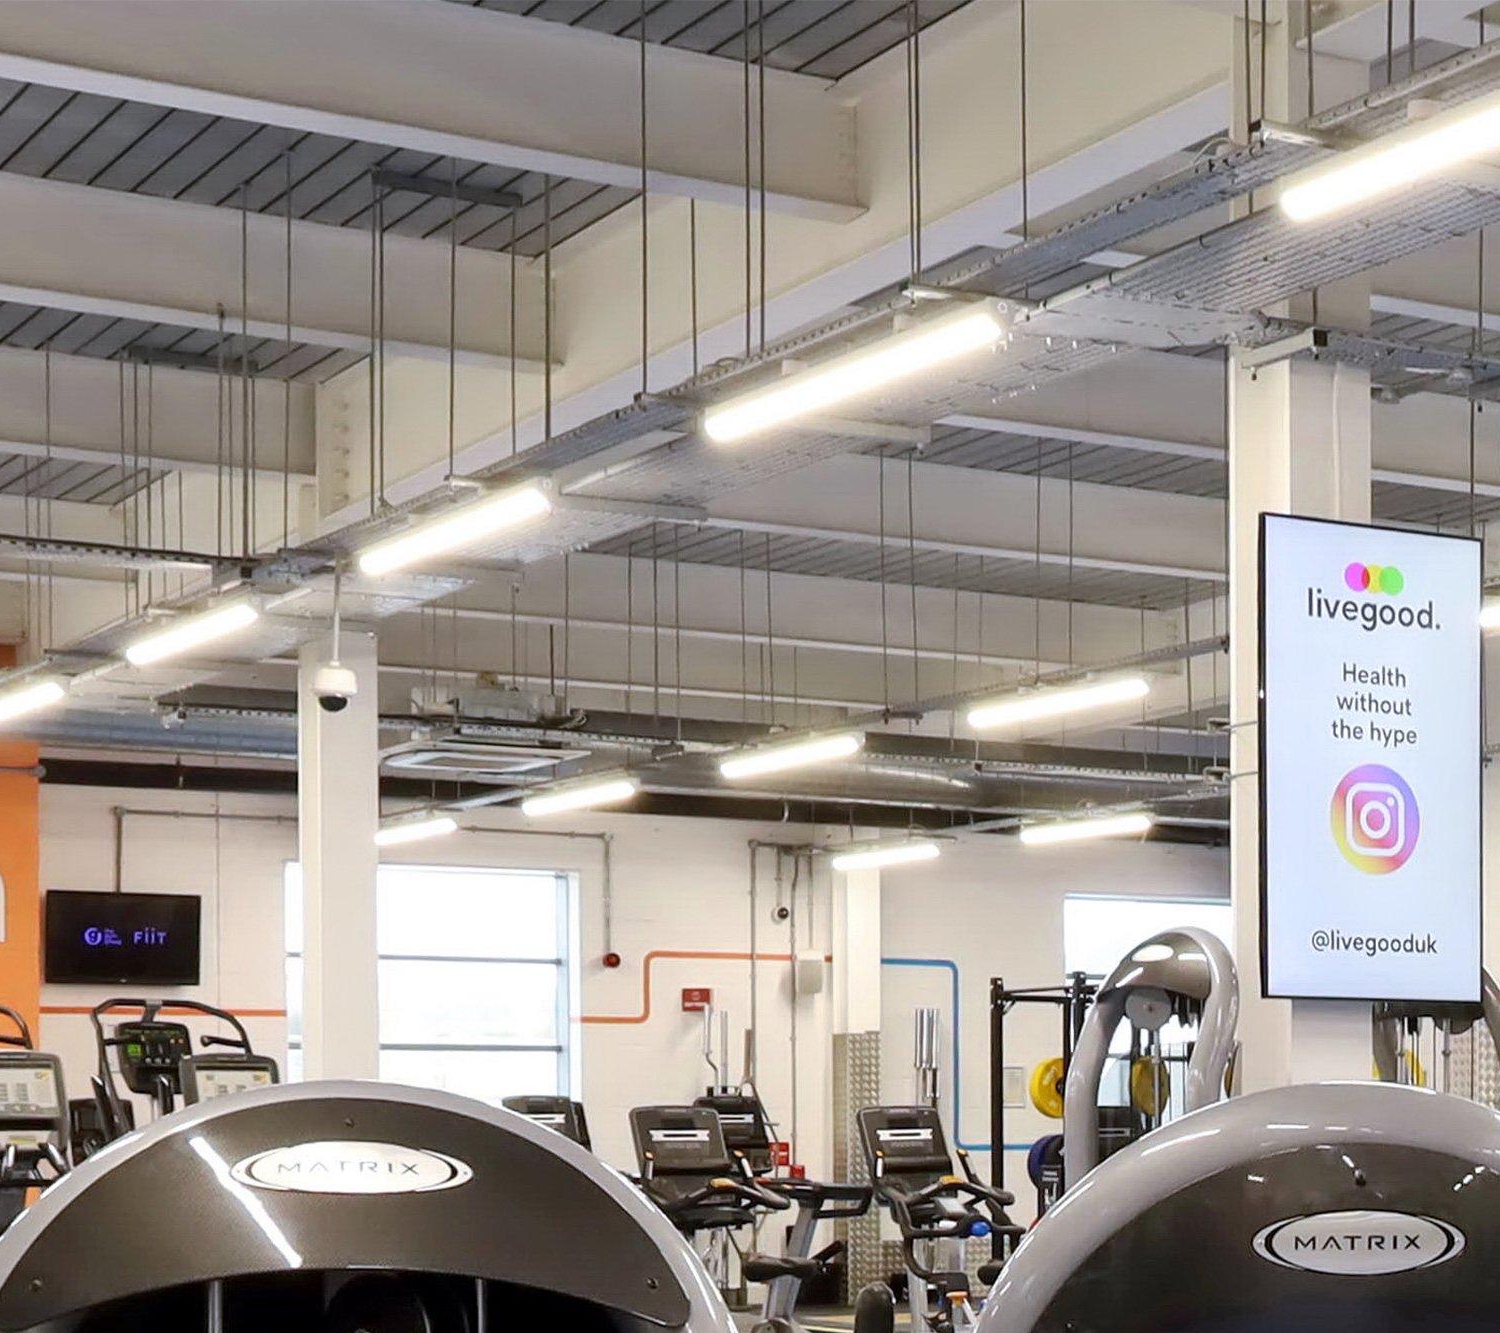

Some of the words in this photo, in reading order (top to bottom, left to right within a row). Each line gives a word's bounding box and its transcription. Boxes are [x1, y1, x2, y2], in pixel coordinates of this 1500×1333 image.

[1308, 587, 1441, 631] livegood.
[1342, 662, 1407, 687] Health
[1336, 692, 1412, 716] without
[1332, 718, 1364, 740] the
[1370, 720, 1417, 748] hype
[1311, 929, 1438, 957] @livegooduk
[277, 1160, 420, 1176] MATRIX
[1294, 1234, 1422, 1251] MATRIX
